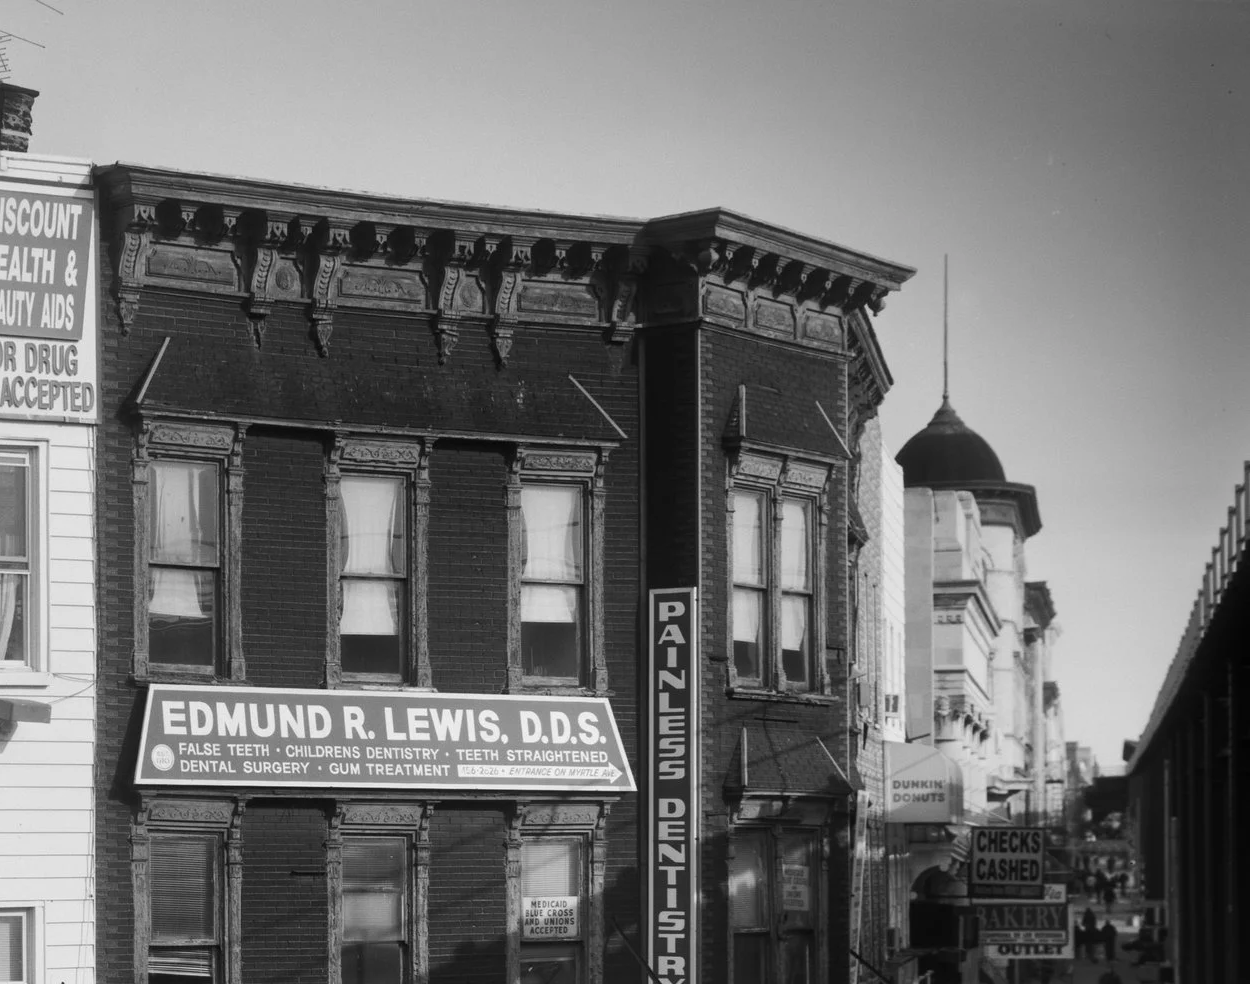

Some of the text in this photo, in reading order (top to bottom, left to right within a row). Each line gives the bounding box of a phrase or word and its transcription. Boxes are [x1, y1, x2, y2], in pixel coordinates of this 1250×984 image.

[64, 249, 78, 288] &
[39, 293, 75, 331] AIDS
[24, 341, 79, 377] DRUG
[0, 375, 95, 413] ACCEPTED
[657, 600, 687, 781] PAINLESS
[161, 700, 608, 746] EDMUND R. LEWIS, D.D.S.
[178, 742, 608, 763] FALSE TEETH CHILDRENS DENTISTRY TEETH STRAIGHTENED
[180, 760, 237, 773] DENTAL
[243, 761, 310, 775] SURGERY
[329, 763, 361, 776] GUM
[366, 764, 450, 777] TREATMENT
[509, 767, 552, 776] ENTRANCE
[554, 767, 567, 777] ON
[569, 768, 600, 777] MYRTLE
[893, 793, 946, 803] DONUTS
[976, 830, 1041, 854] CHECKS
[976, 858, 1040, 881] CASHED
[525, 909, 574, 917] BLUE CROSS
[531, 900, 567, 908] MEDICAID
[524, 917, 575, 926] AND UNIONS
[976, 905, 1064, 929] BAKERY
[530, 926, 568, 934] ACCEPTED
[998, 944, 1064, 956] OUTLET
